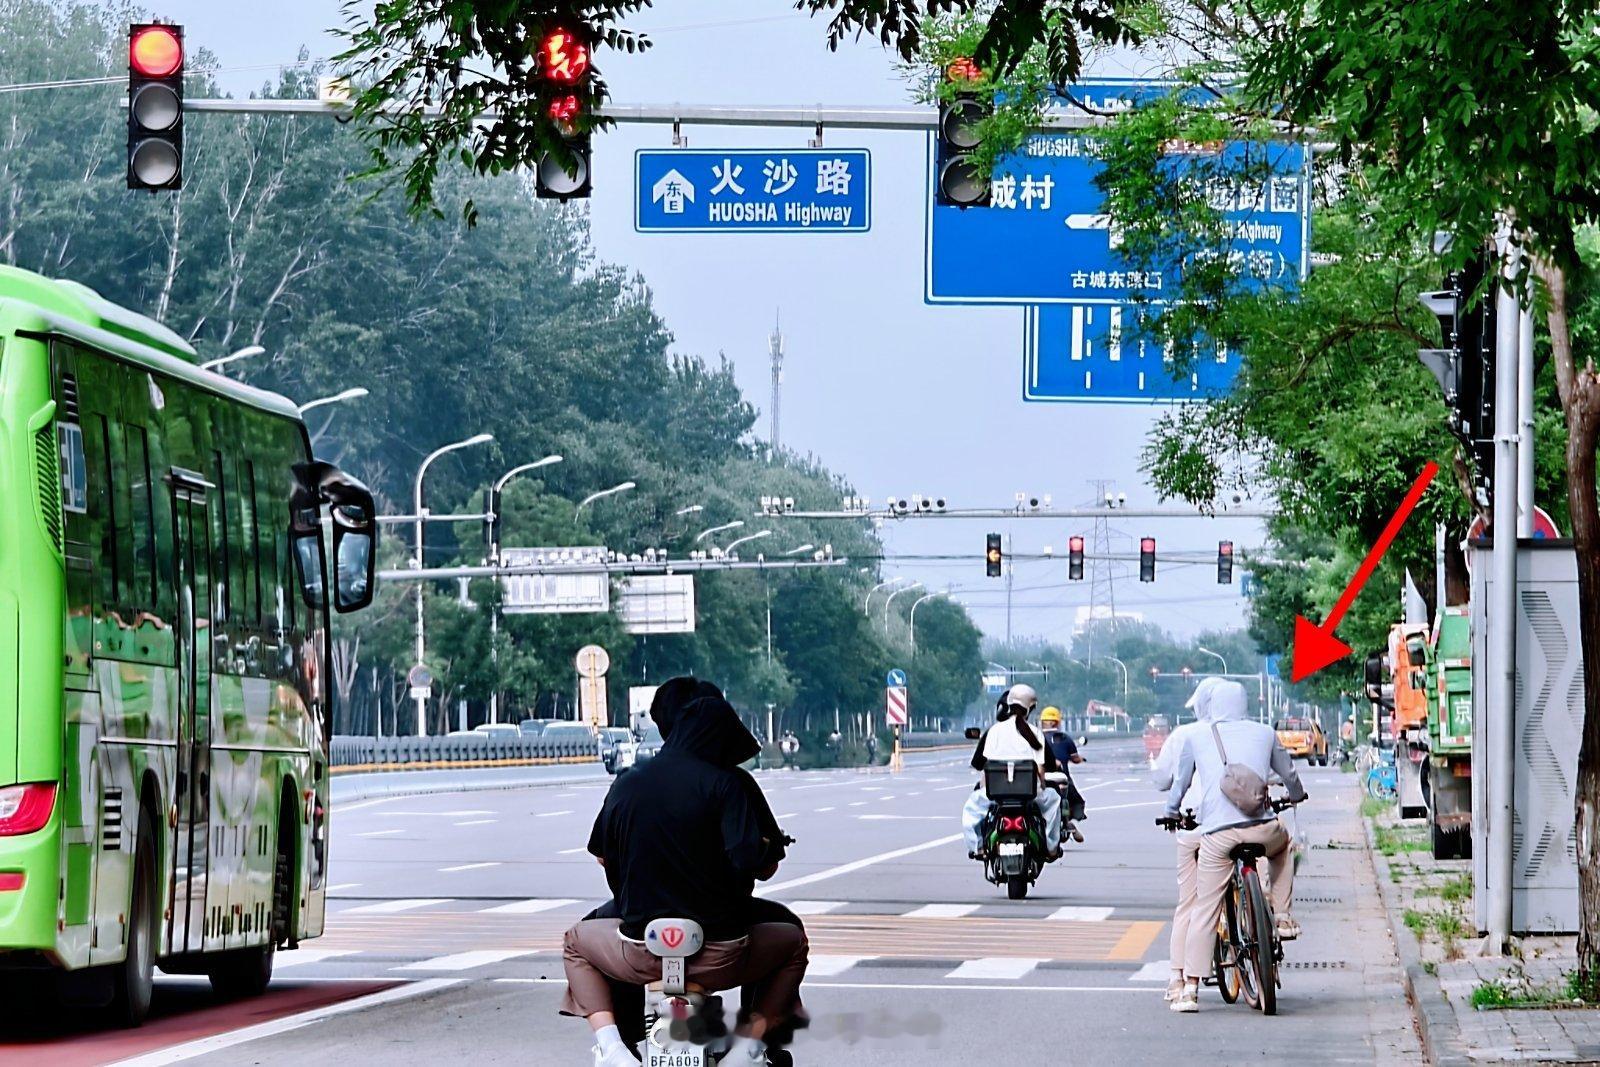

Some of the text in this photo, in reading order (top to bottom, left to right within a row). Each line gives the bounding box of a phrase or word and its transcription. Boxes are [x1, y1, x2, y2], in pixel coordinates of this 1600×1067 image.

[1027, 137, 1081, 158] HUOSHA
[709, 158, 852, 196] 火沙路
[665, 181, 682, 198] 东
[668, 200, 679, 212] E
[708, 202, 852, 227] HUOSHA Highway
[1237, 220, 1283, 244] Highway
